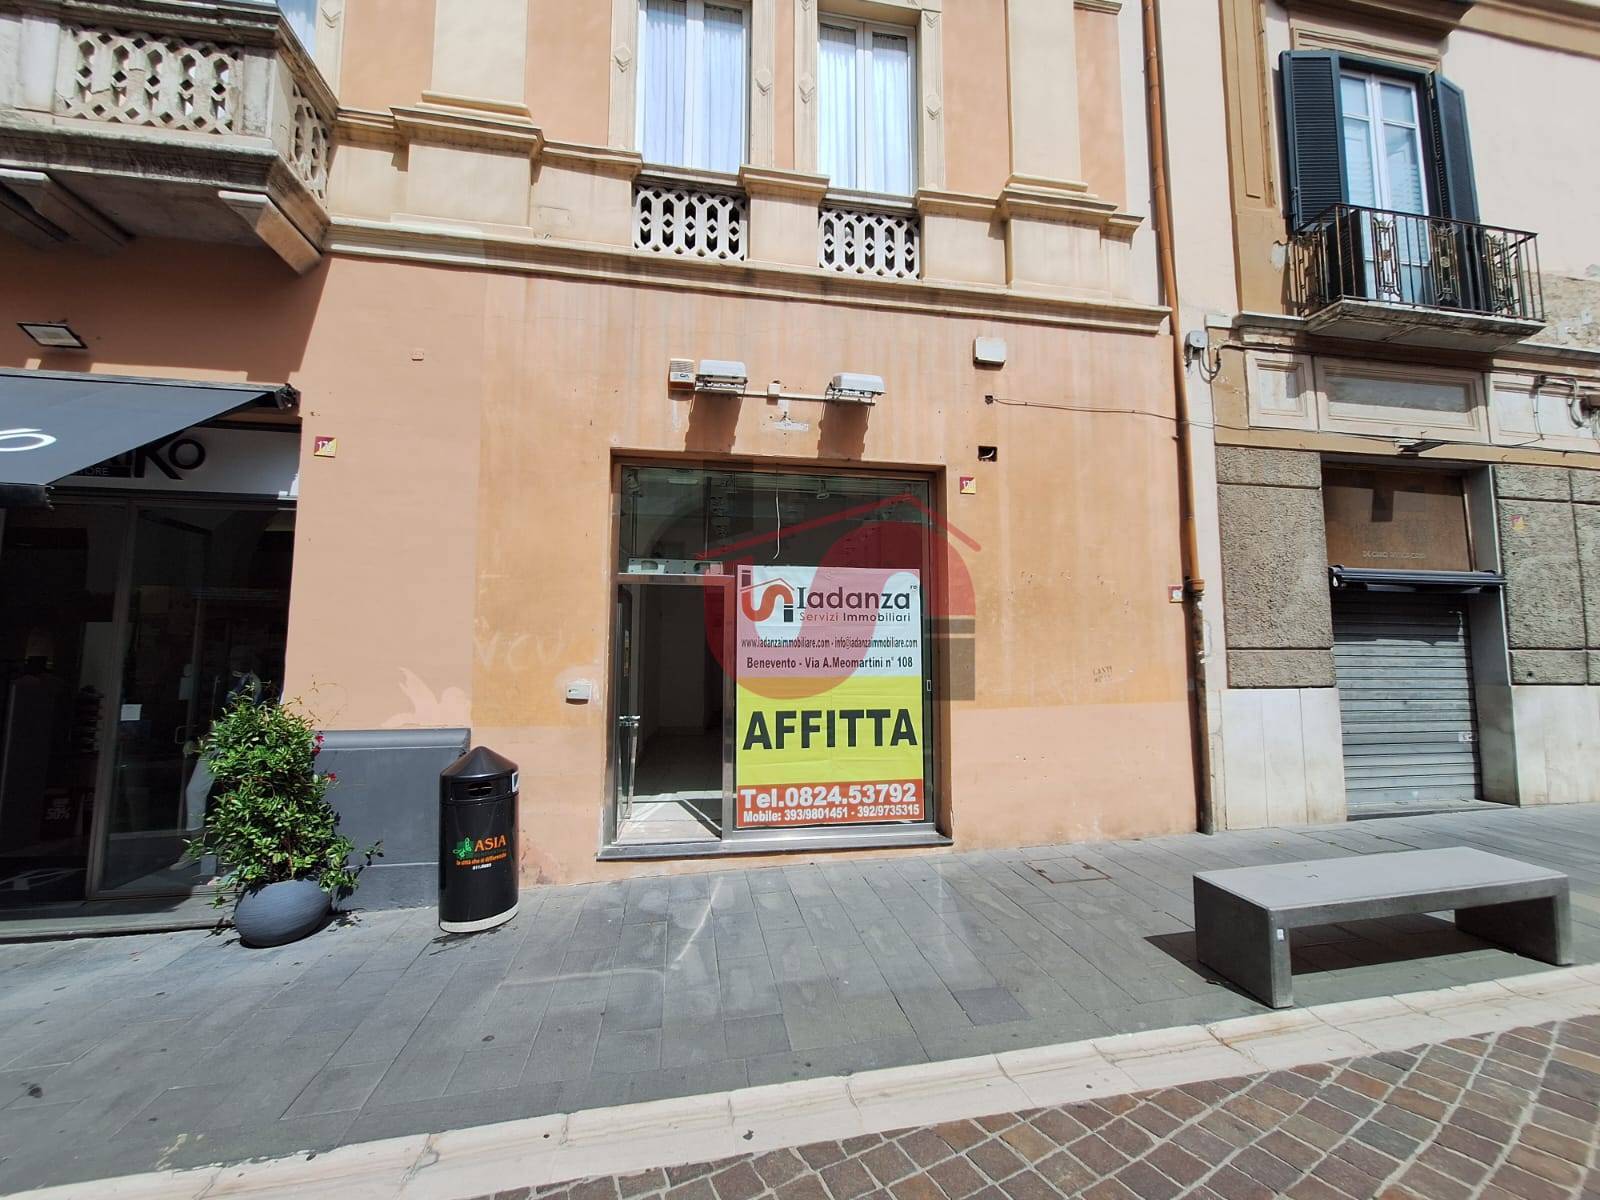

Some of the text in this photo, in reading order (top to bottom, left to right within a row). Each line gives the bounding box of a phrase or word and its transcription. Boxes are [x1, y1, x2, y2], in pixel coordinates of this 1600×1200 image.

[797, 586, 911, 610] Iadanza
[800, 611, 911, 622] Servizi Immobiliari
[741, 636, 830, 649] www.iadanzaimmobiliare.com
[834, 636, 918, 650] info@iadanzaimmobiliare.com
[747, 657, 796, 669] Benevento
[805, 657, 820, 669] Via
[823, 656, 883, 669] A.Meomartini
[898, 656, 913, 668] 108
[742, 708, 918, 751] AFFITTA
[740, 783, 917, 809] Tel.0824.53792
[743, 810, 781, 823] Mobile:
[784, 808, 848, 821] 393/9801451
[857, 805, 920, 818] 392/9735315
[474, 835, 506, 852] ASIA
